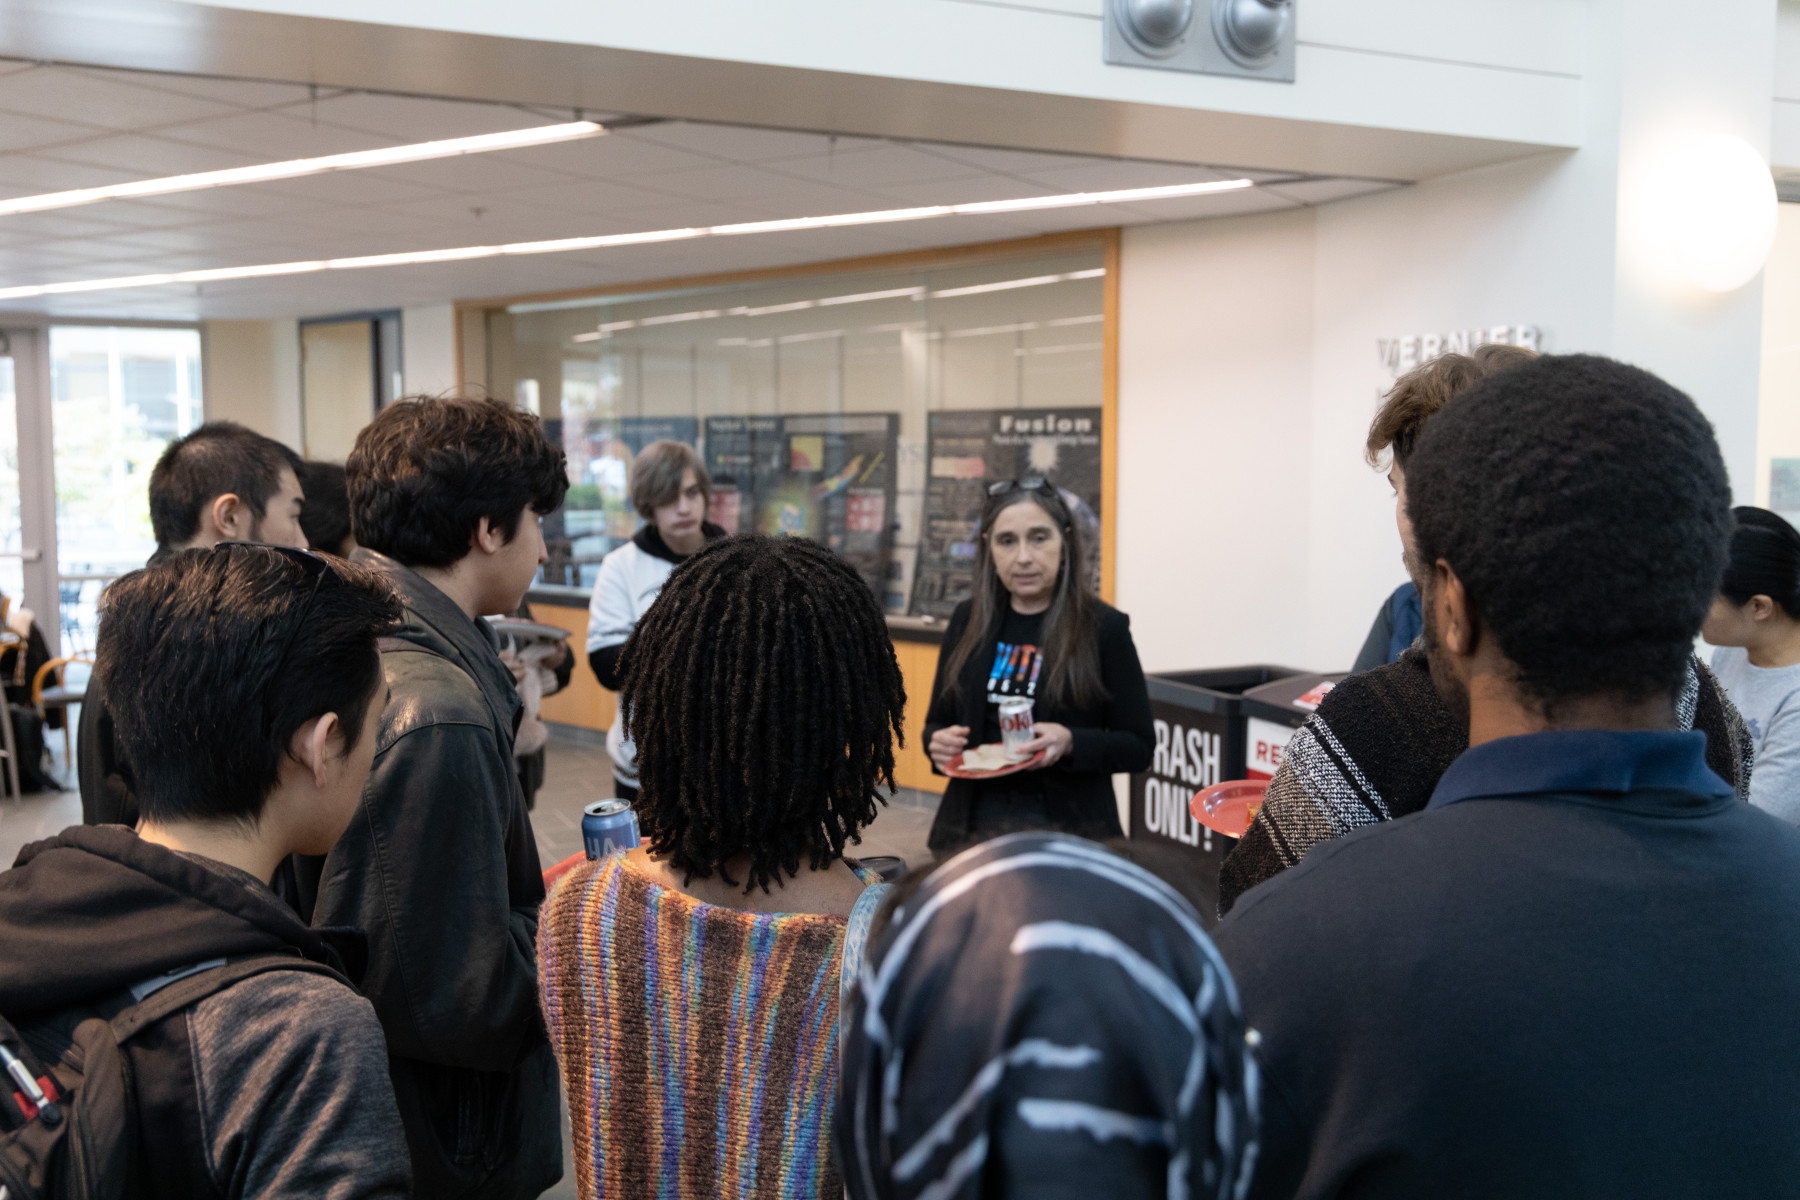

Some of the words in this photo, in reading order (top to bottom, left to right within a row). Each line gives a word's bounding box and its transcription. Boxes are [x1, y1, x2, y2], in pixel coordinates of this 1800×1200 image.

[1376, 324, 1542, 368] VERNIER
[999, 413, 1092, 434] Fusion
[1152, 719, 1221, 787] RASH
[1256, 740, 1281, 766] RE
